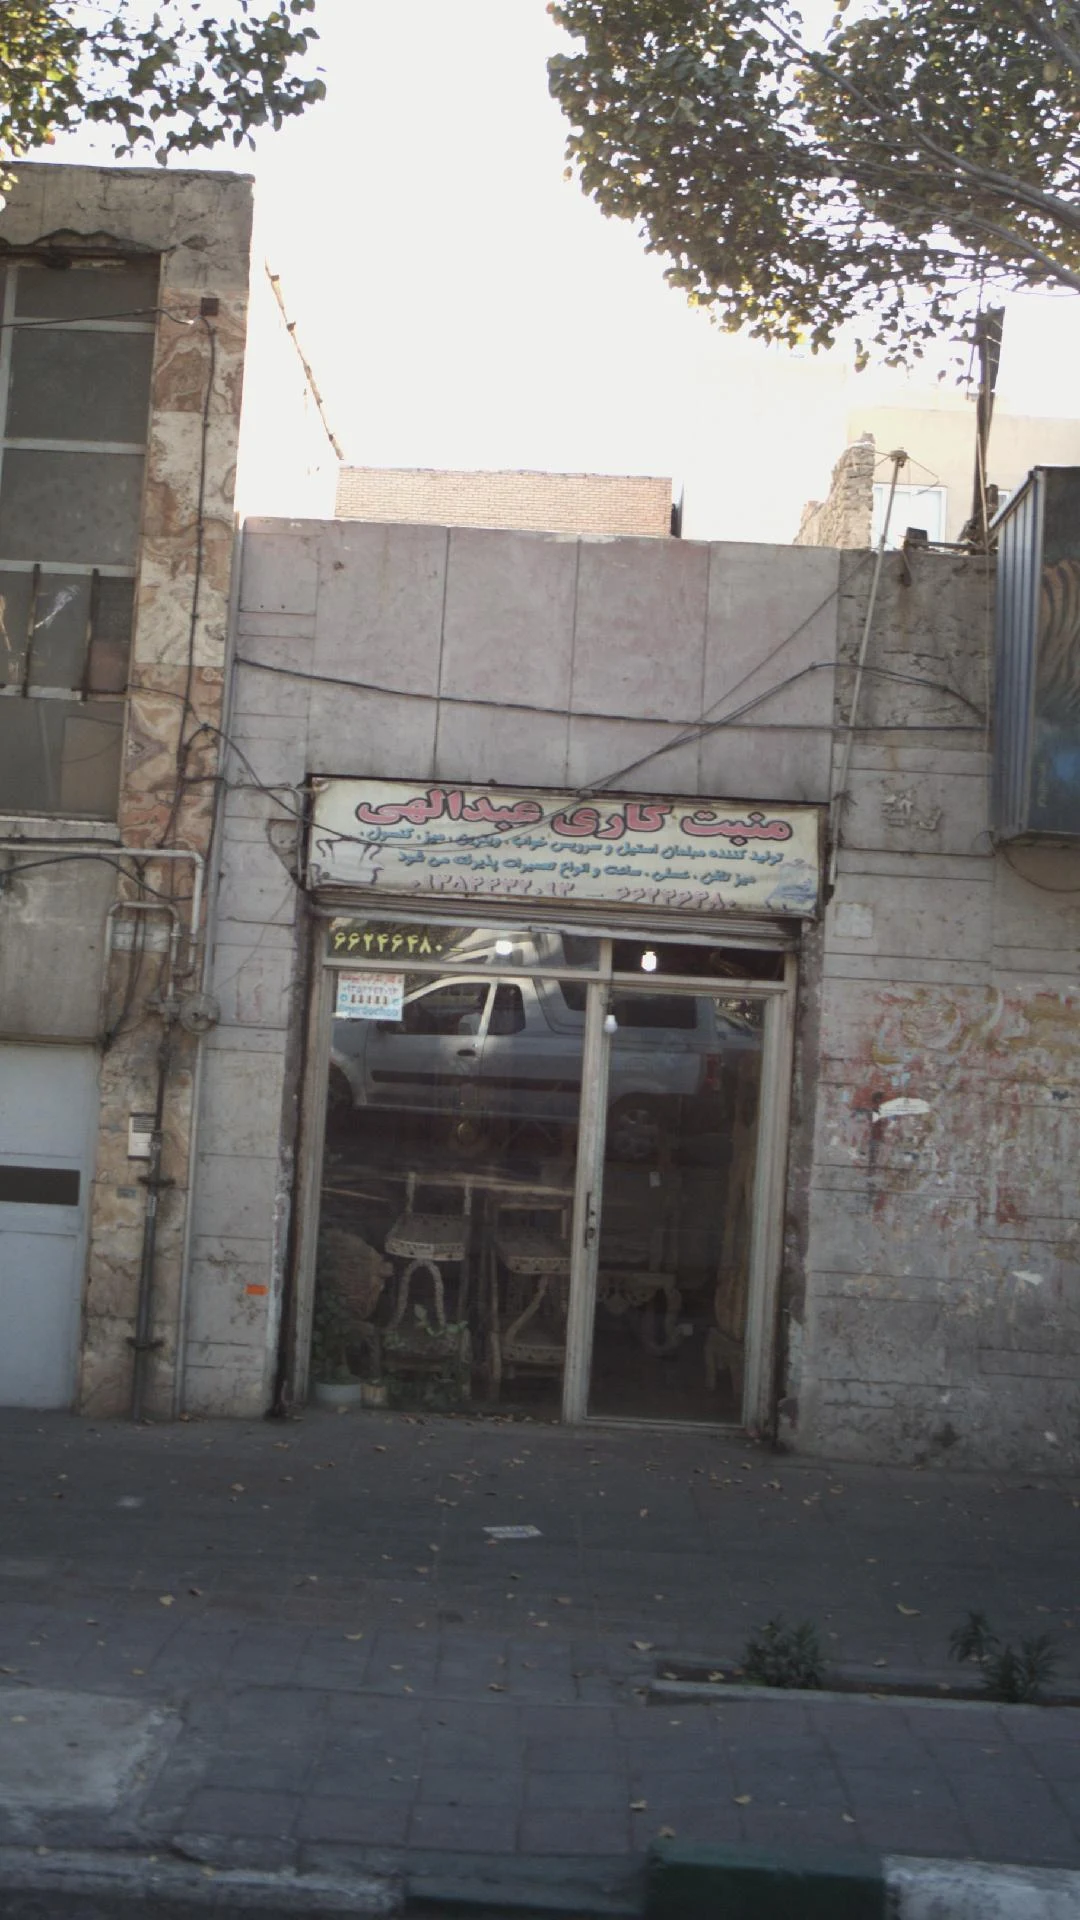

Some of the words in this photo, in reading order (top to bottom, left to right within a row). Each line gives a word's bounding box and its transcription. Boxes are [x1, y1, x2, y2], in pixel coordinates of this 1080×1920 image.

[355, 789, 544, 832] عبدالهی
[550, 802, 674, 839] کاری
[680, 810, 794, 846] منبت
[511, 835, 548, 851] خواب
[551, 840, 603, 854] سرویس
[604, 845, 613, 855] و
[616, 841, 659, 857] استیل
[661, 845, 706, 859] مبلمان
[709, 847, 747, 861] کننده
[750, 852, 784, 866] تولید
[334, 932, 443, 954] ۶۶۲۴۶۴۸۰
